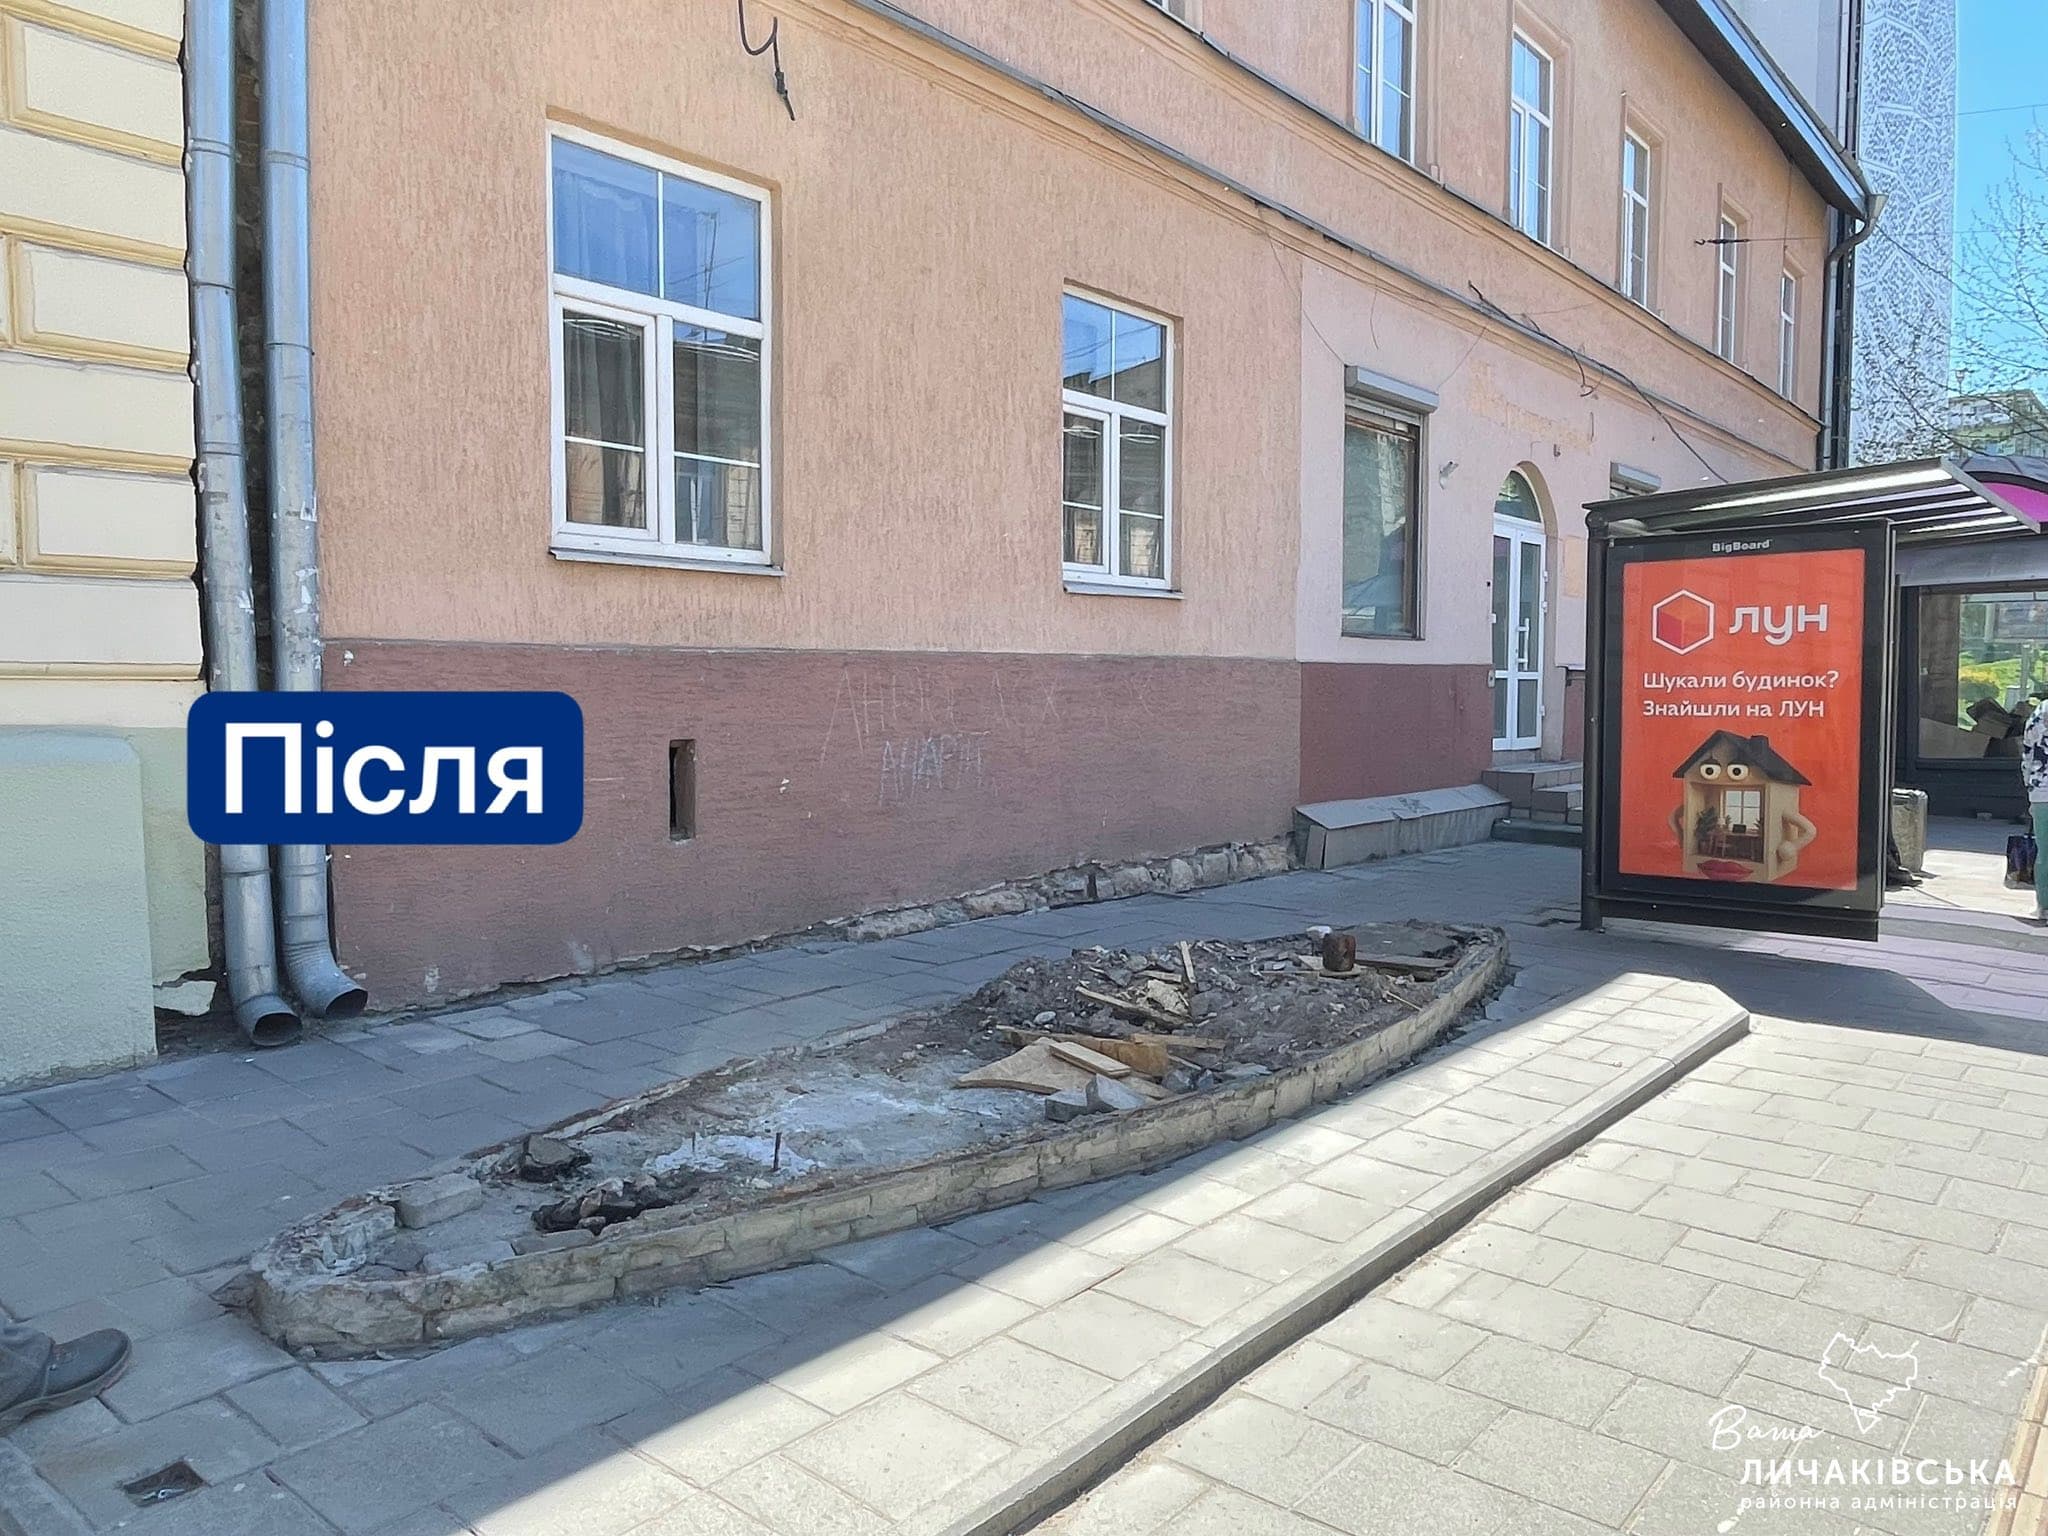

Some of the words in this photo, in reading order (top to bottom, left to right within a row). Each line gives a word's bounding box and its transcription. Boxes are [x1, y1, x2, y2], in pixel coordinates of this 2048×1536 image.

[1712, 539, 1770, 553] BigBoard
[1643, 671, 1727, 692] Шукали
[1732, 669, 1840, 692] будинок?
[1643, 699, 1740, 718] Знайшли
[1746, 703, 1772, 718] на
[1779, 700, 1824, 718] ЛУН
